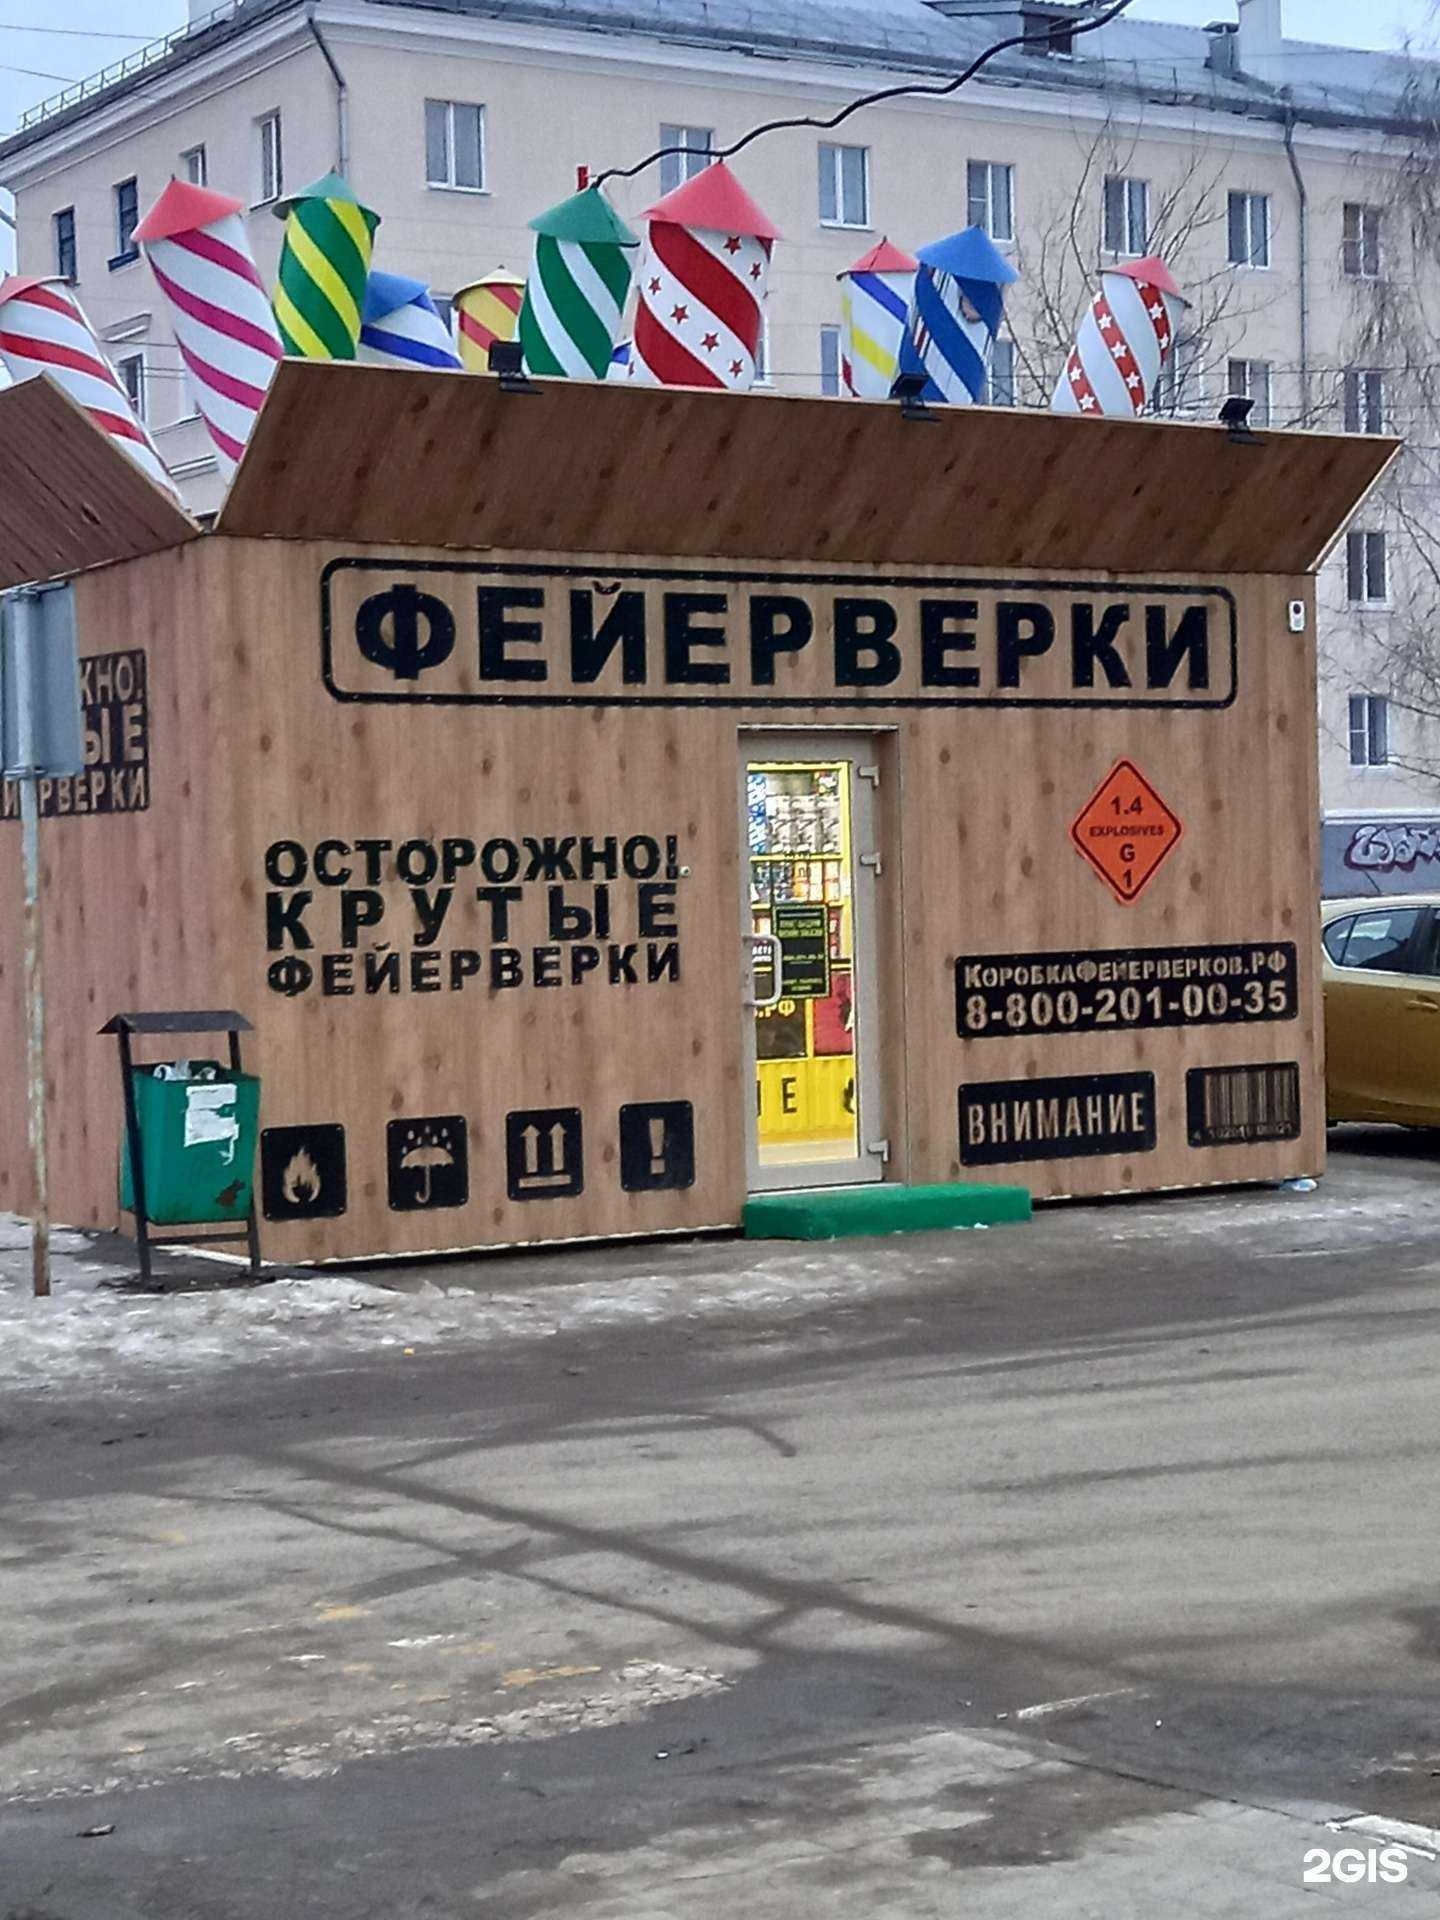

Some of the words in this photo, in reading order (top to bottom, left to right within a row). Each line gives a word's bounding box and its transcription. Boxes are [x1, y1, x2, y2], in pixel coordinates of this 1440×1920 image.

[355, 580, 1209, 689] ФЕЙЕРВЕРКИ
[1089, 825, 1164, 837] EXPLOSIVES
[1111, 795, 1143, 815] 1.4
[264, 834, 679, 887] ОСТОРОЖНО!
[1119, 843, 1135, 862] G
[1123, 869, 1132, 887] 1
[266, 882, 679, 951] КРУТЫЕ
[267, 942, 680, 997] ФЕЙЕРВЕРКИ
[965, 980, 1288, 1031] 8-800-201-00-35
[967, 1092, 1146, 1146] ВНИМАНИЕ
